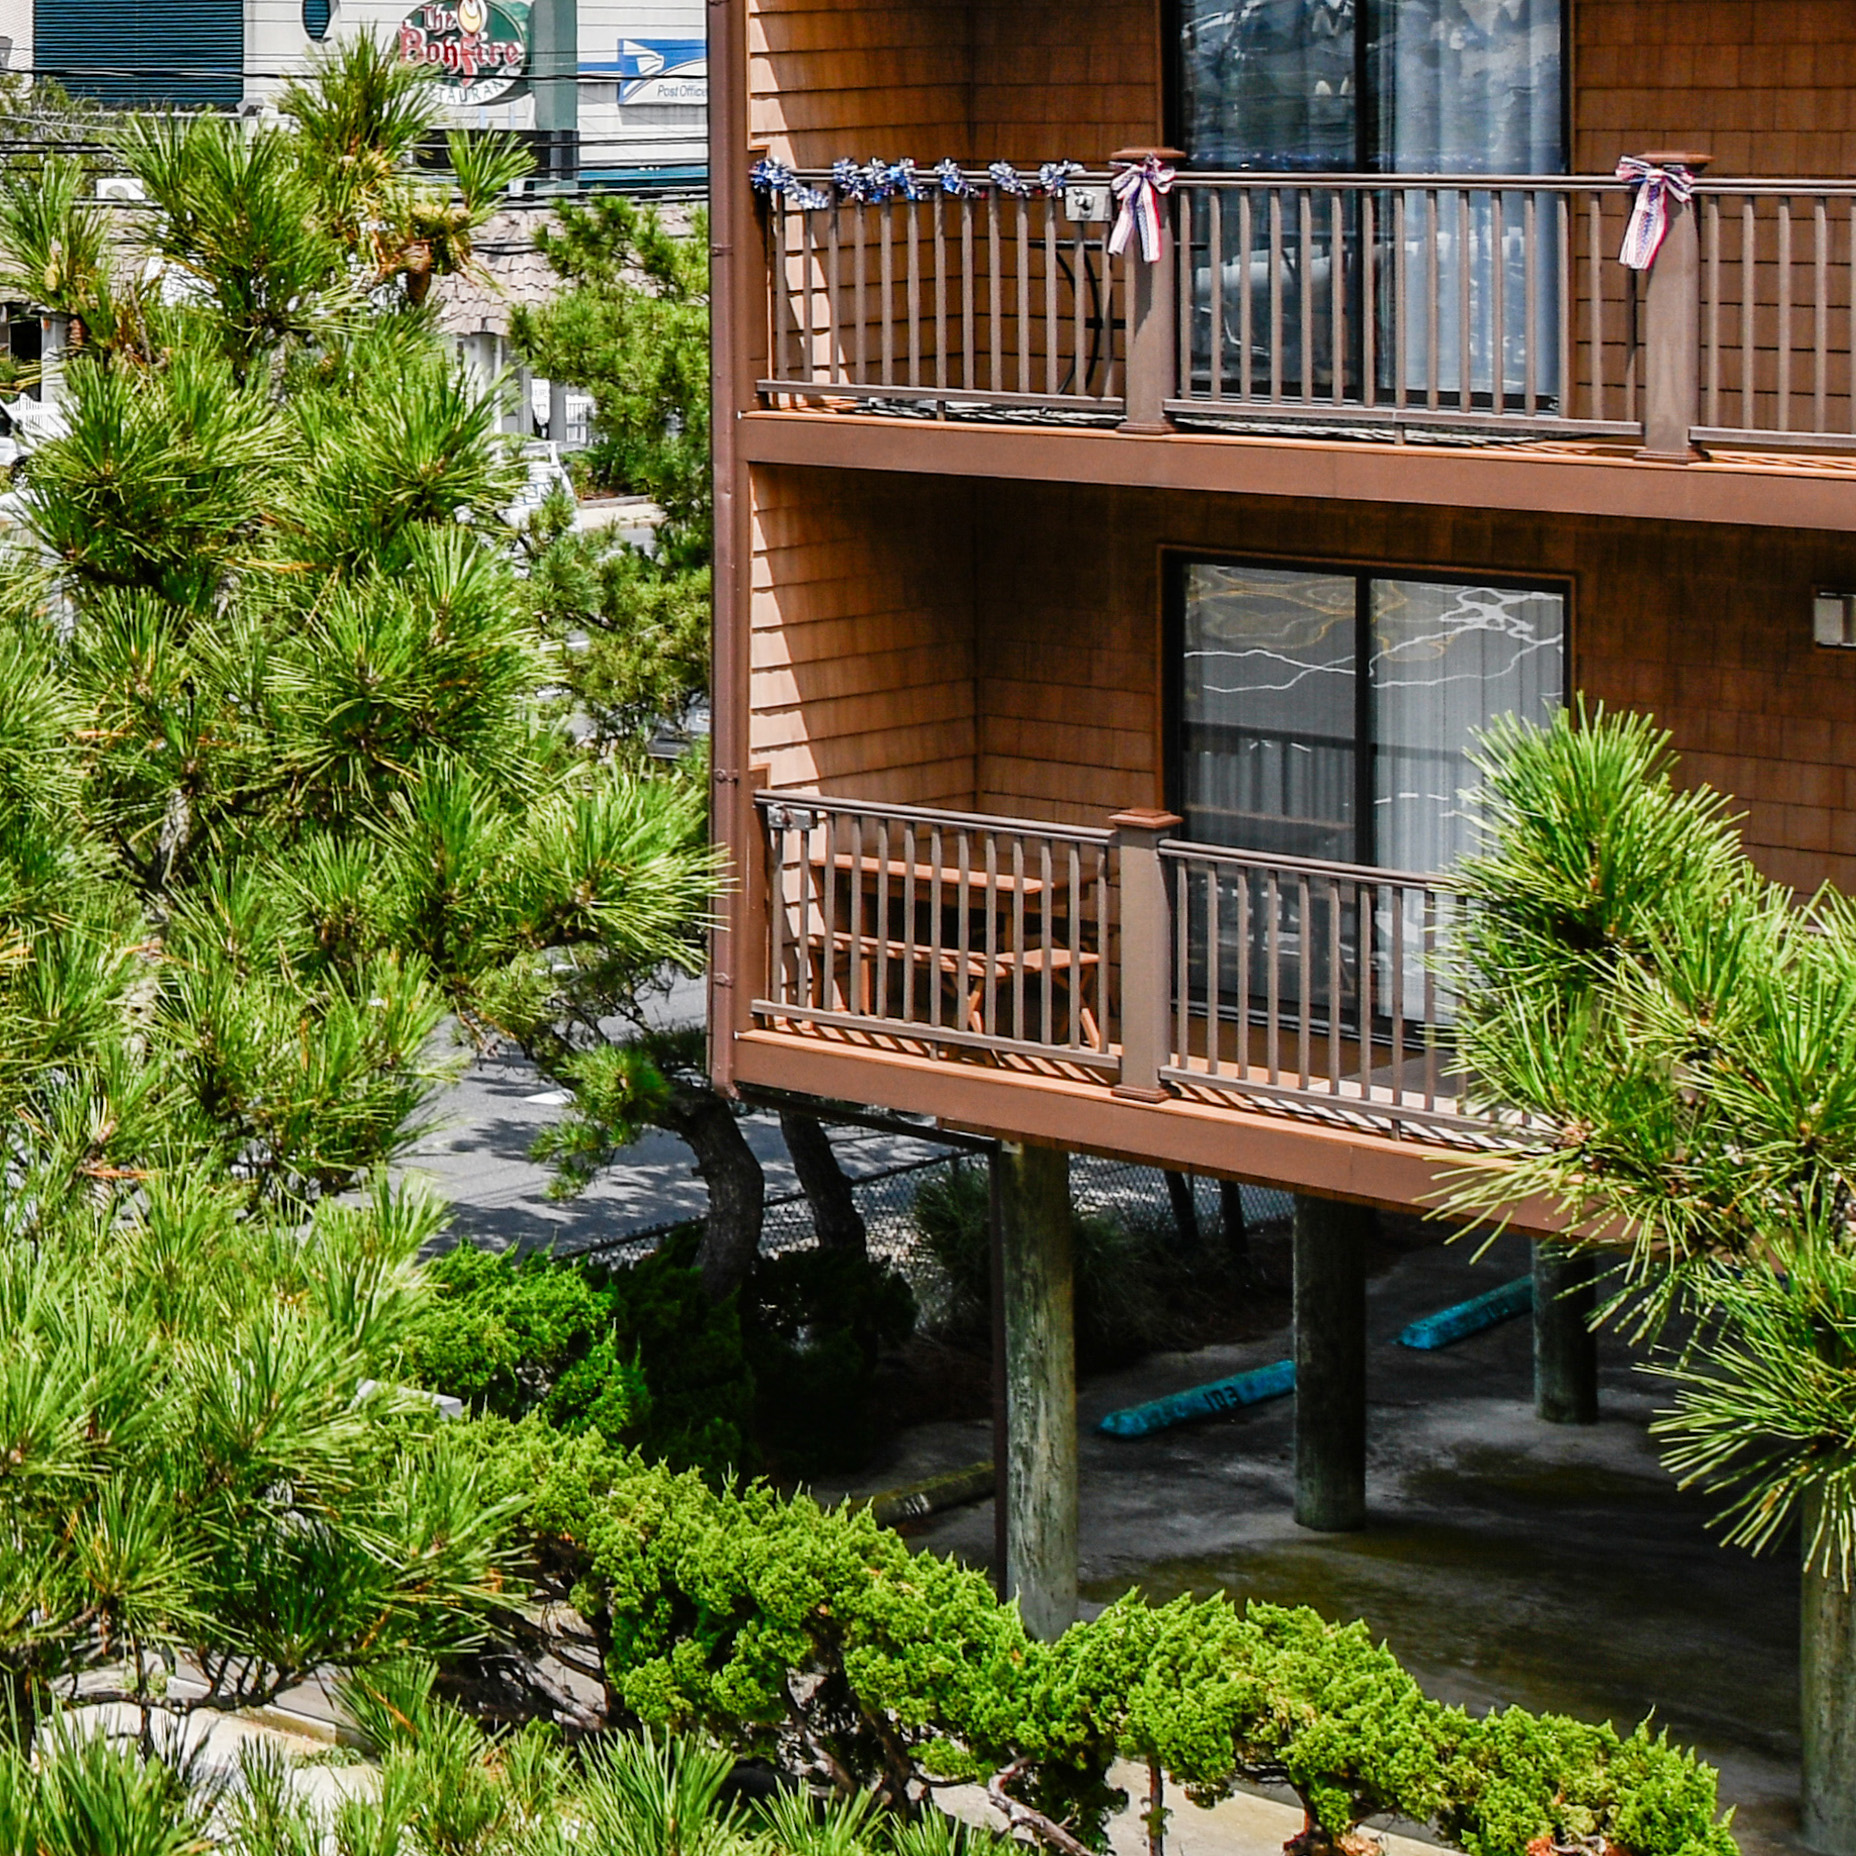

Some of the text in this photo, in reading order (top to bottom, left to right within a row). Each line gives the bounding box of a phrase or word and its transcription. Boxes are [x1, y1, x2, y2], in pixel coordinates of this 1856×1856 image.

[419, 5, 456, 34] The
[398, 20, 521, 87] Bonfire
[657, 84, 677, 97] Post
